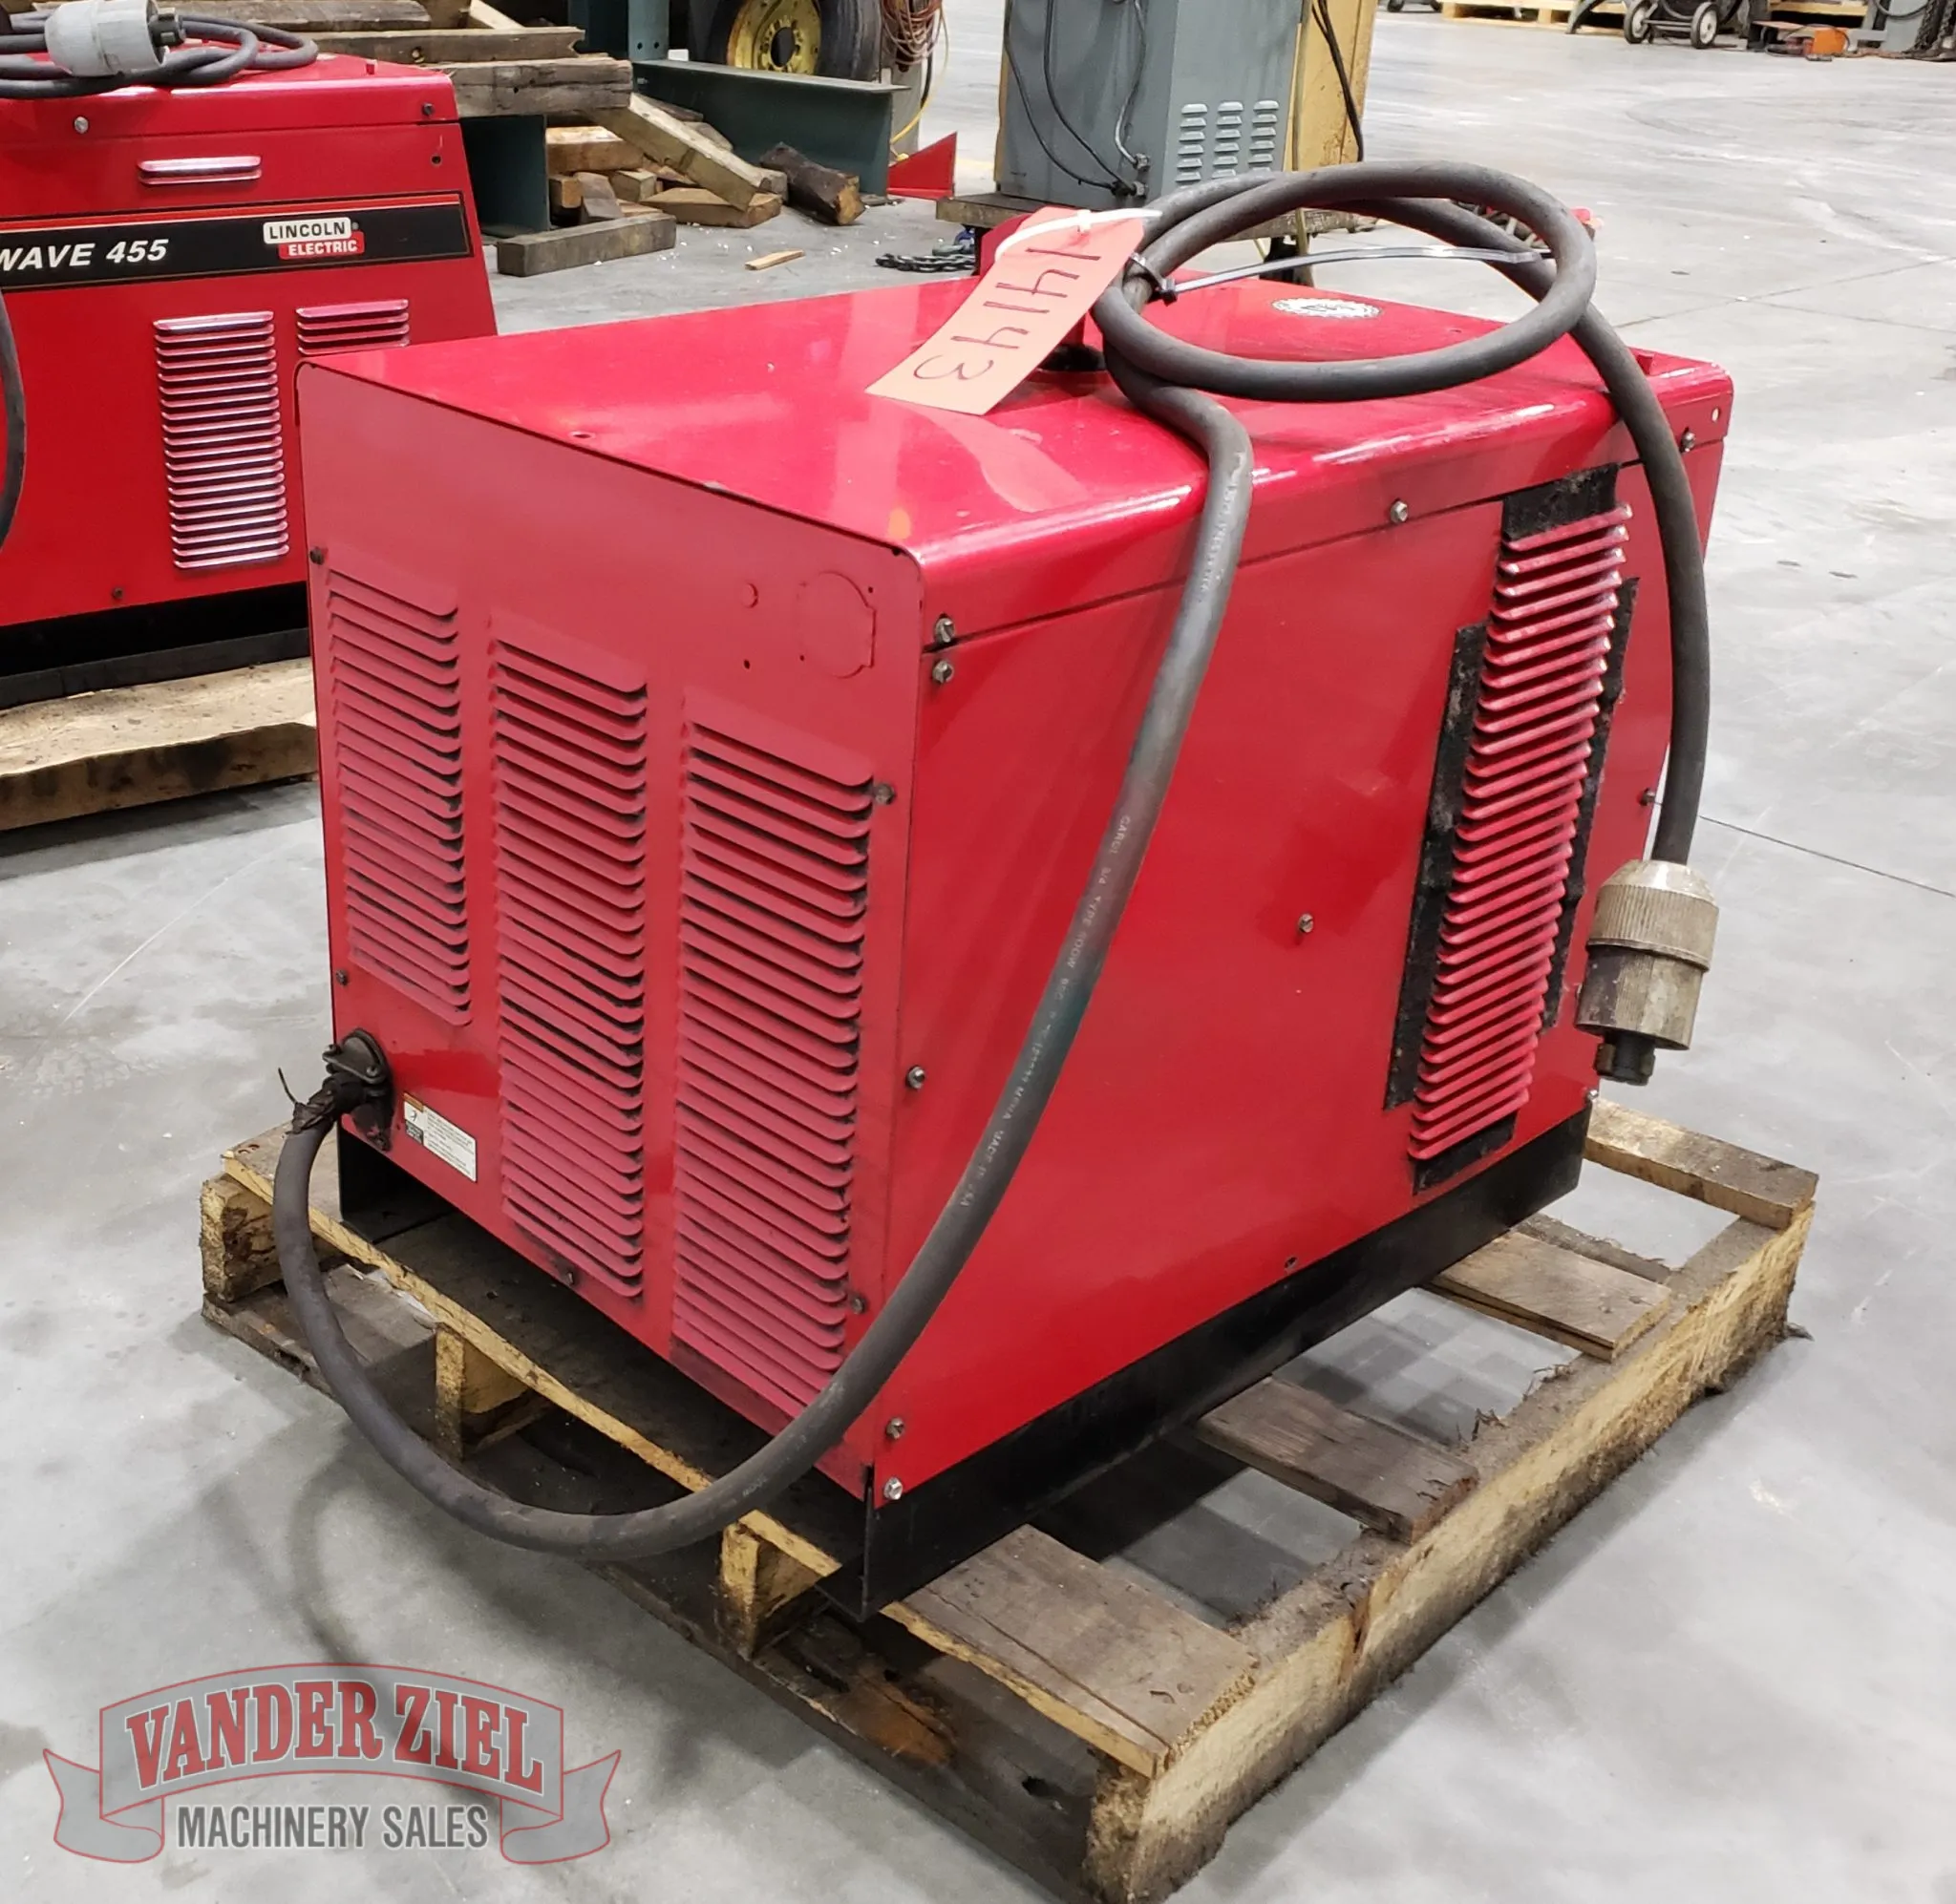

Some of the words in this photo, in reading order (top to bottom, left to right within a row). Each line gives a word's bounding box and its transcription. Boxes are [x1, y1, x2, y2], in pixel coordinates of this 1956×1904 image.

[269, 221, 346, 240] LINCOLN
[105, 239, 169, 264] 455
[288, 240, 358, 256] ELECTRIC
[913, 247, 1101, 380] 14143
